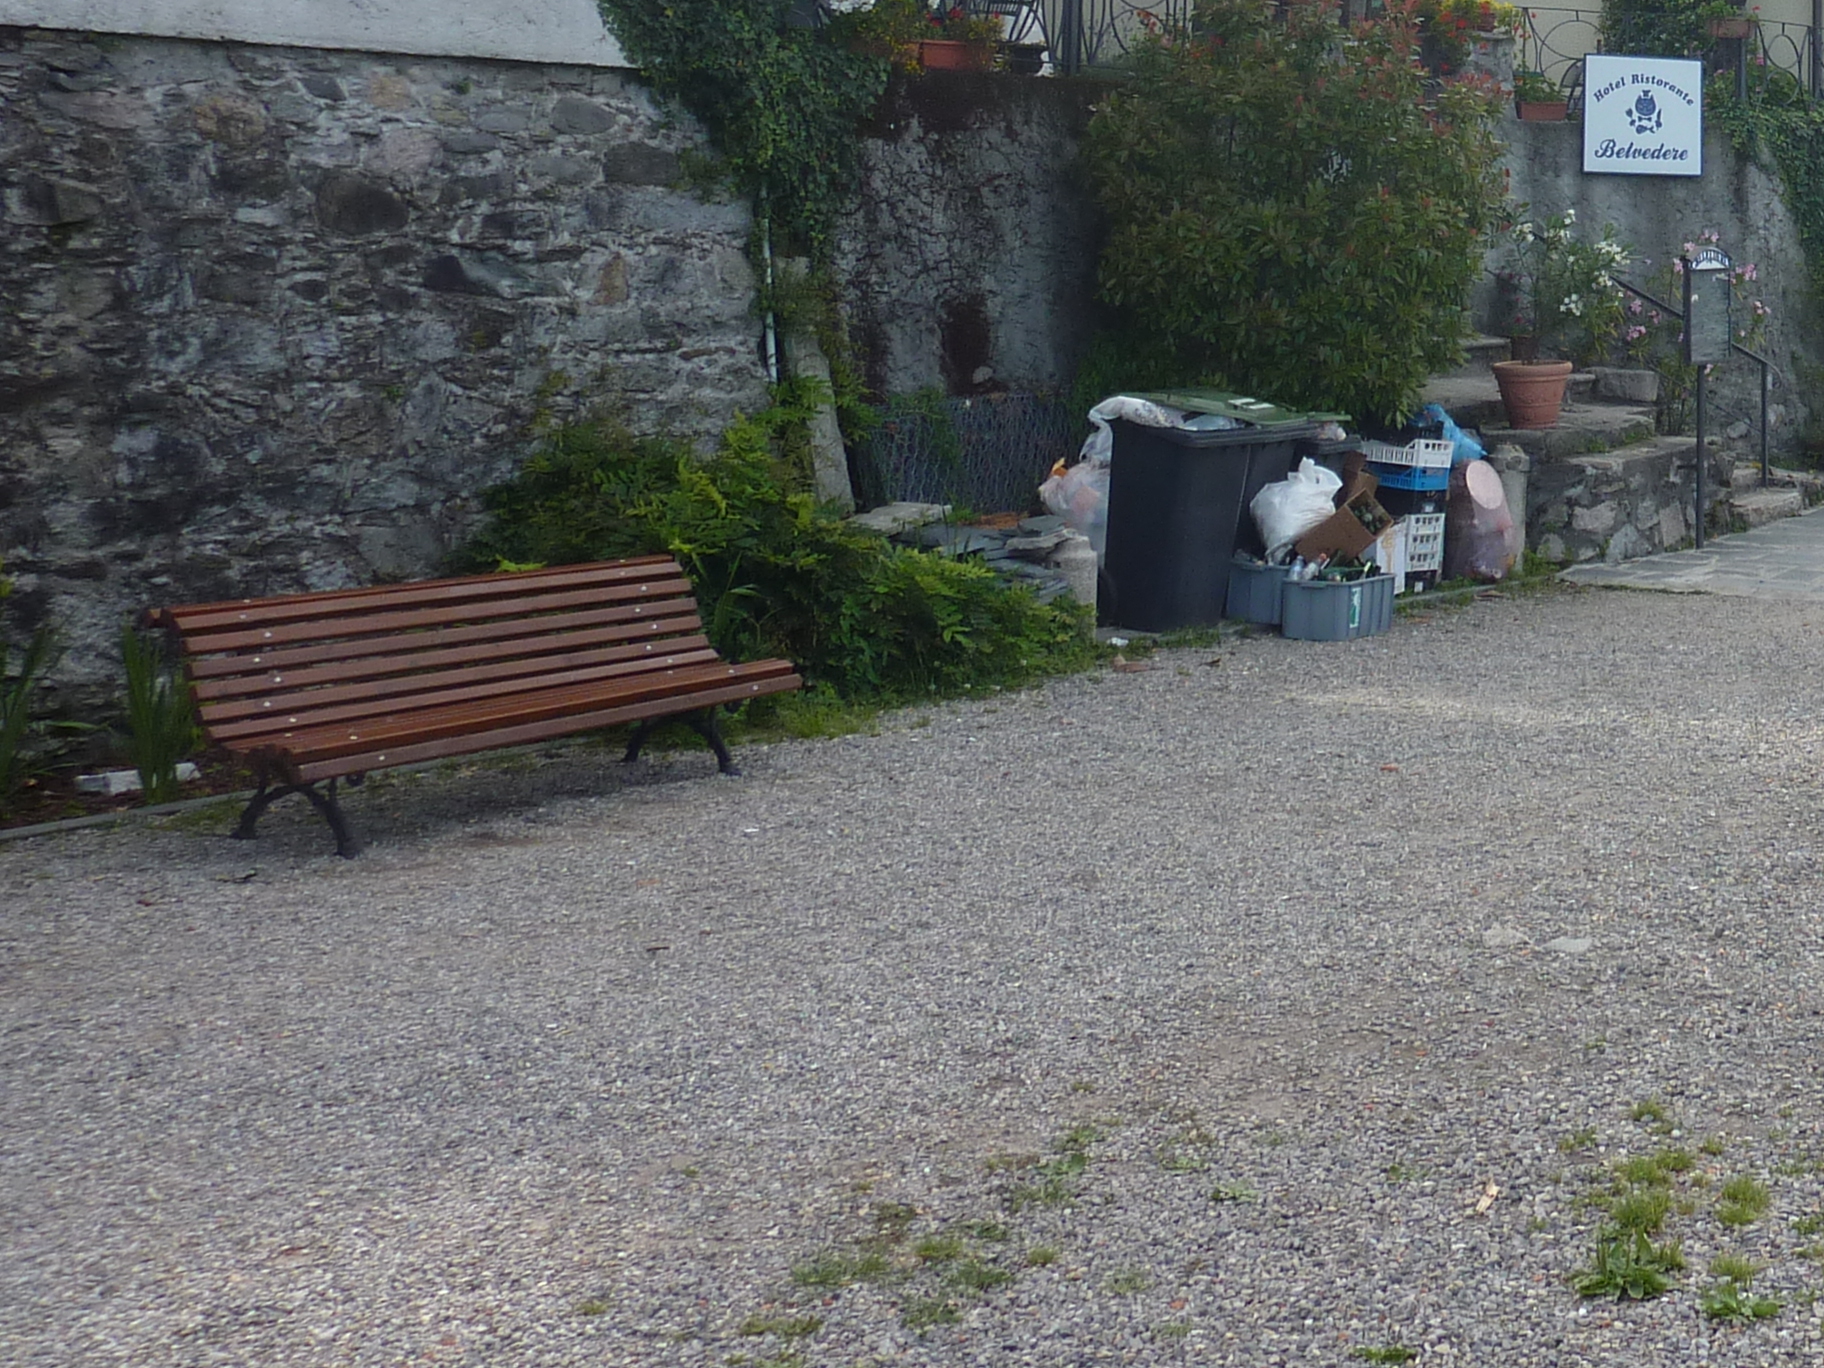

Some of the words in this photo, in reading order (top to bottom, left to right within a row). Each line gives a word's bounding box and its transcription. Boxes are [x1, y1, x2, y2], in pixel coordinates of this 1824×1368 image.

[1593, 76, 1626, 103] Hotel
[1631, 73, 1694, 106] Ristorante
[1594, 138, 1689, 161] Belvedere
